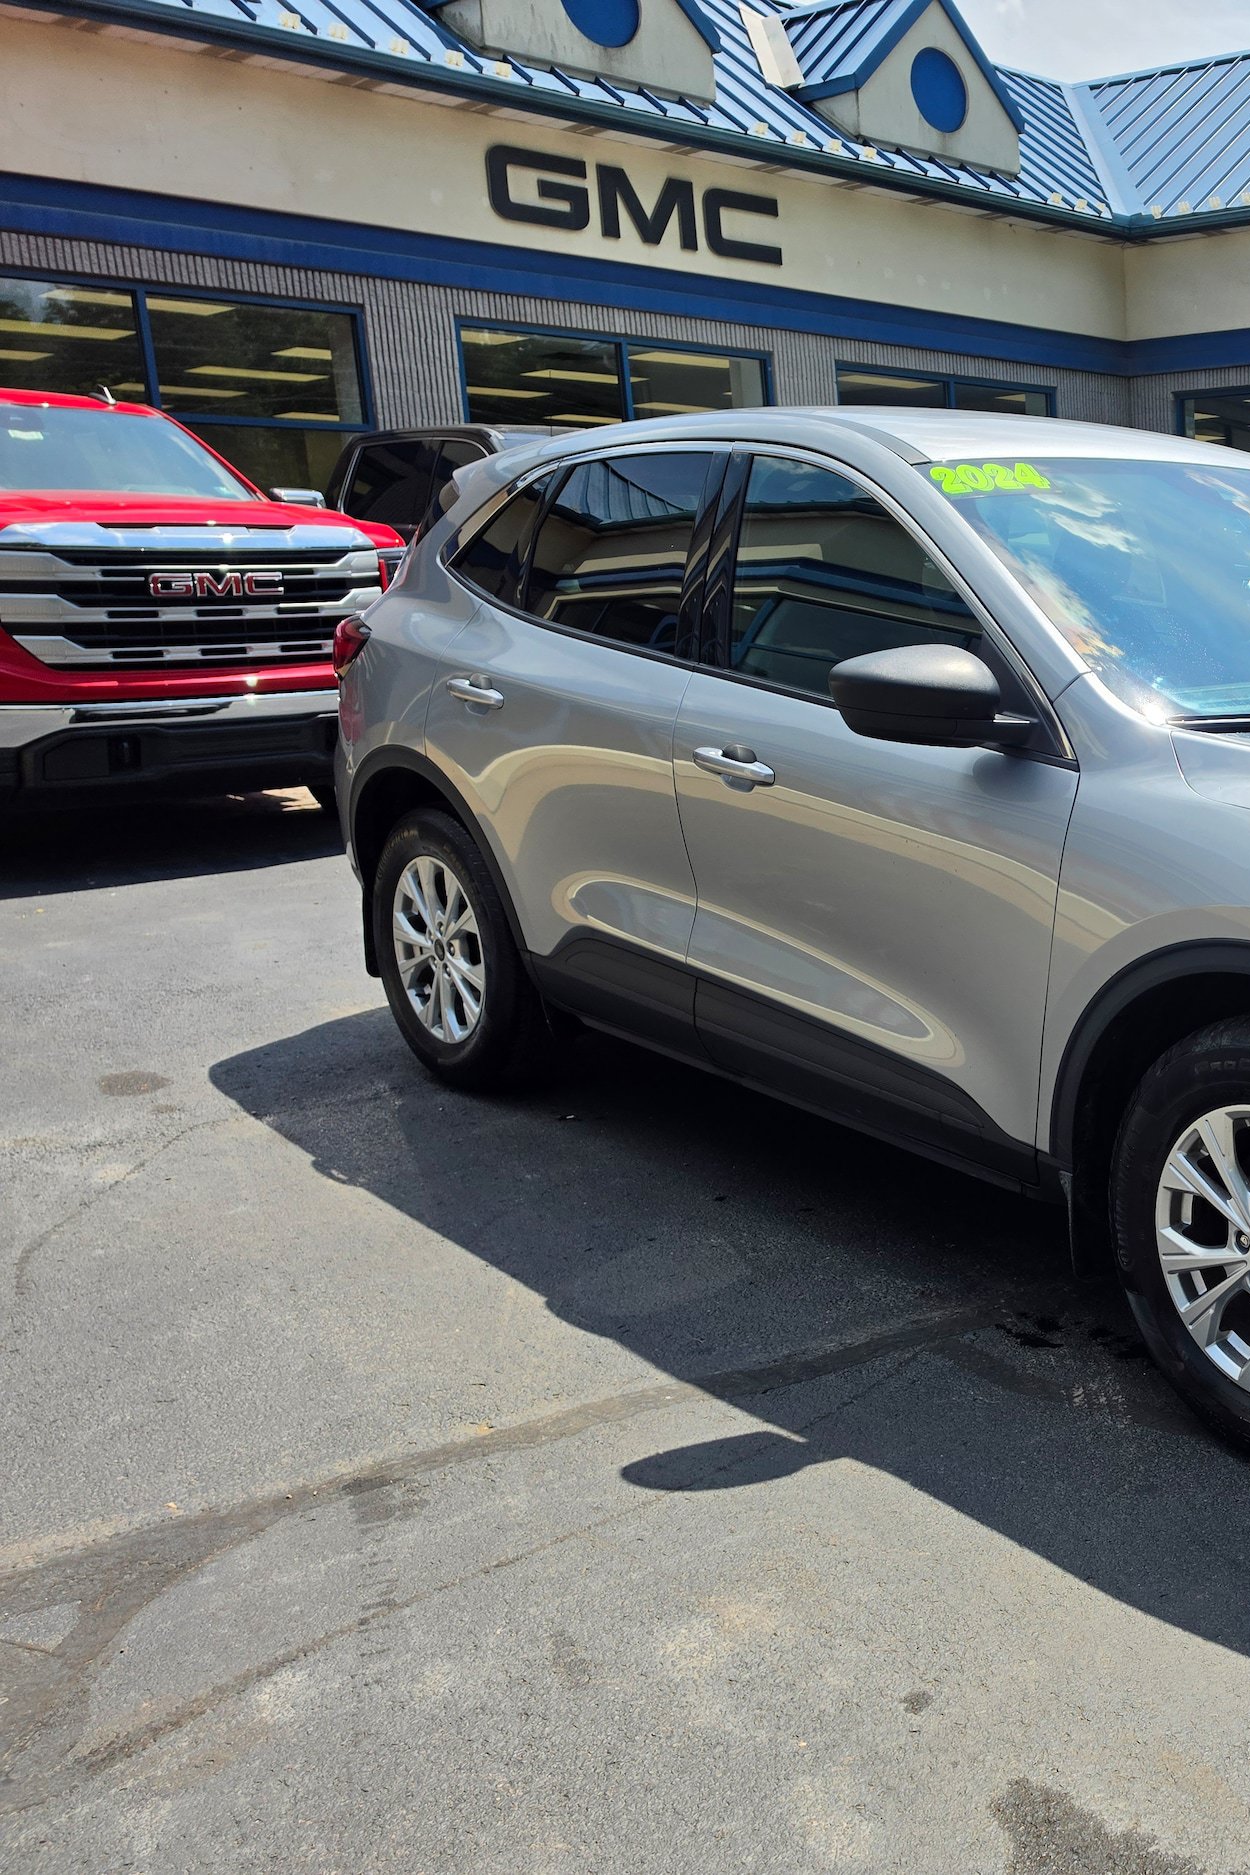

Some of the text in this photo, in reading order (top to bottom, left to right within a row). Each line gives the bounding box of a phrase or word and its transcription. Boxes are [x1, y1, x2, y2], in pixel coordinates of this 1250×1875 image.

[484, 144, 783, 266] GMC
[930, 463, 1050, 494] 2024
[149, 572, 285, 597] GMC
